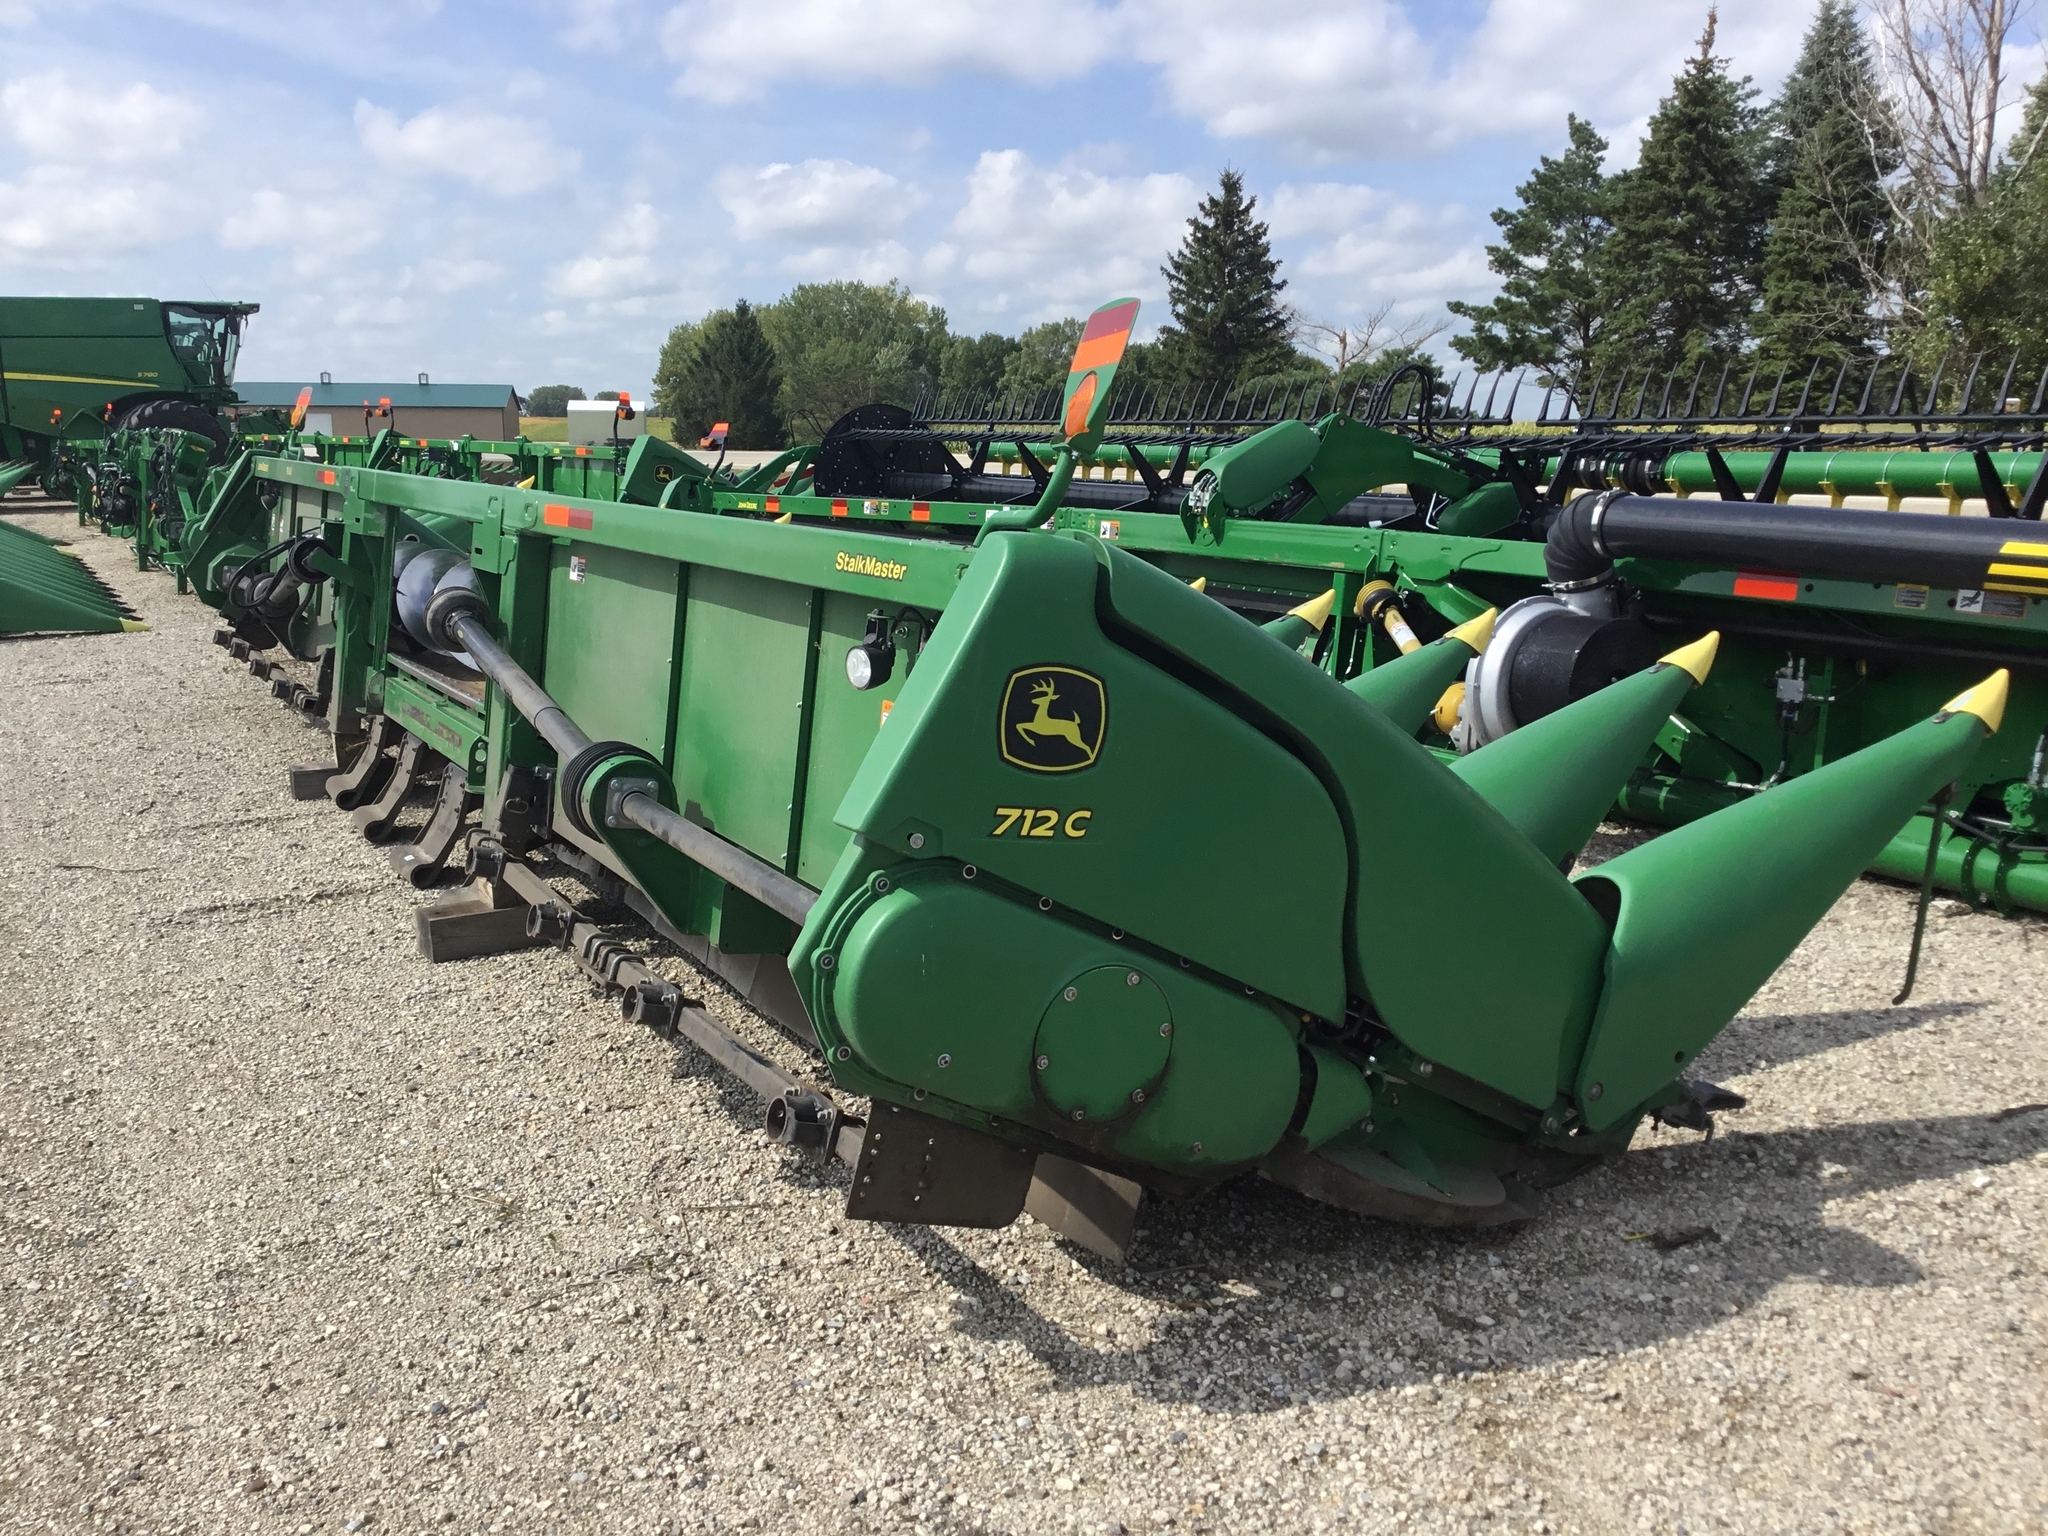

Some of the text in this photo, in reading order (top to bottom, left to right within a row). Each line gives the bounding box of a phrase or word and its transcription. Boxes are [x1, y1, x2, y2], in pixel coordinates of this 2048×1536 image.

[835, 551, 907, 580] StalkMaster
[991, 806, 1092, 838] 712 C
